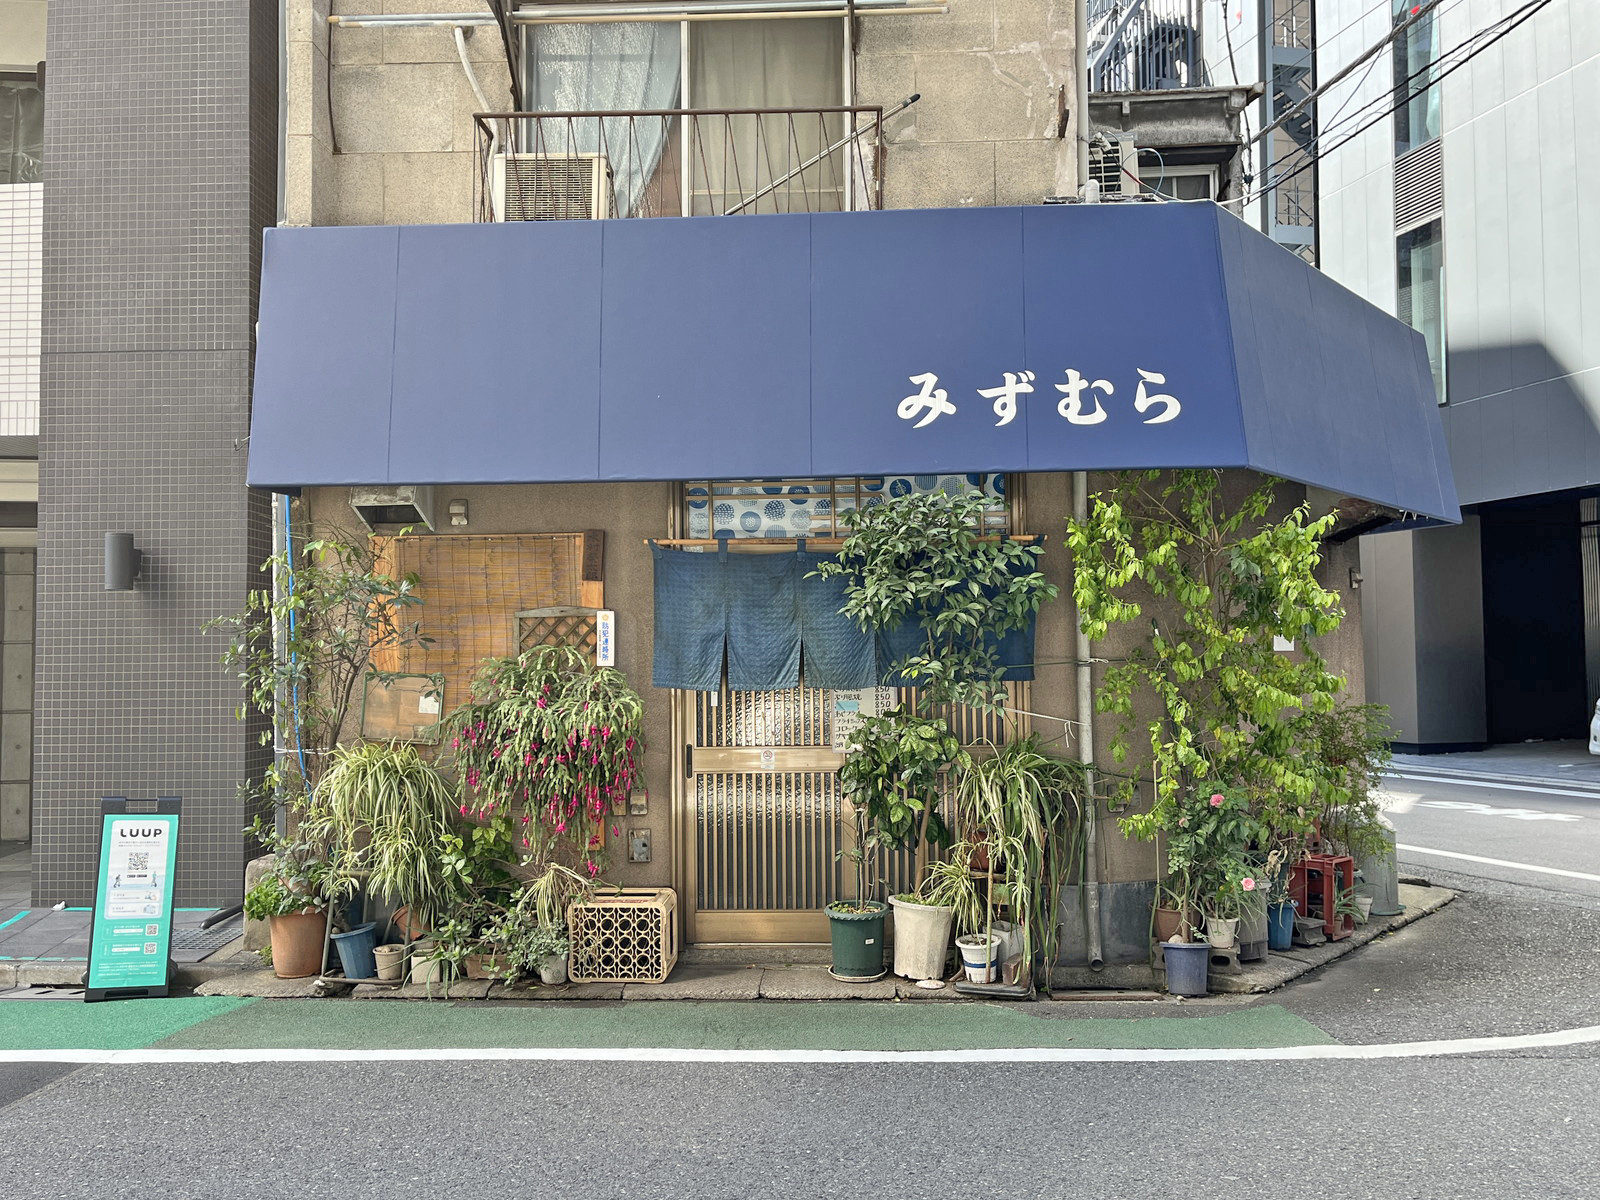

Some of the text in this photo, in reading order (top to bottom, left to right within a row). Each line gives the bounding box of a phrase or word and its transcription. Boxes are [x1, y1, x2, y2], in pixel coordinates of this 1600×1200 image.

[897, 367, 1182, 429] みずむら
[120, 828, 162, 838] LUUP
